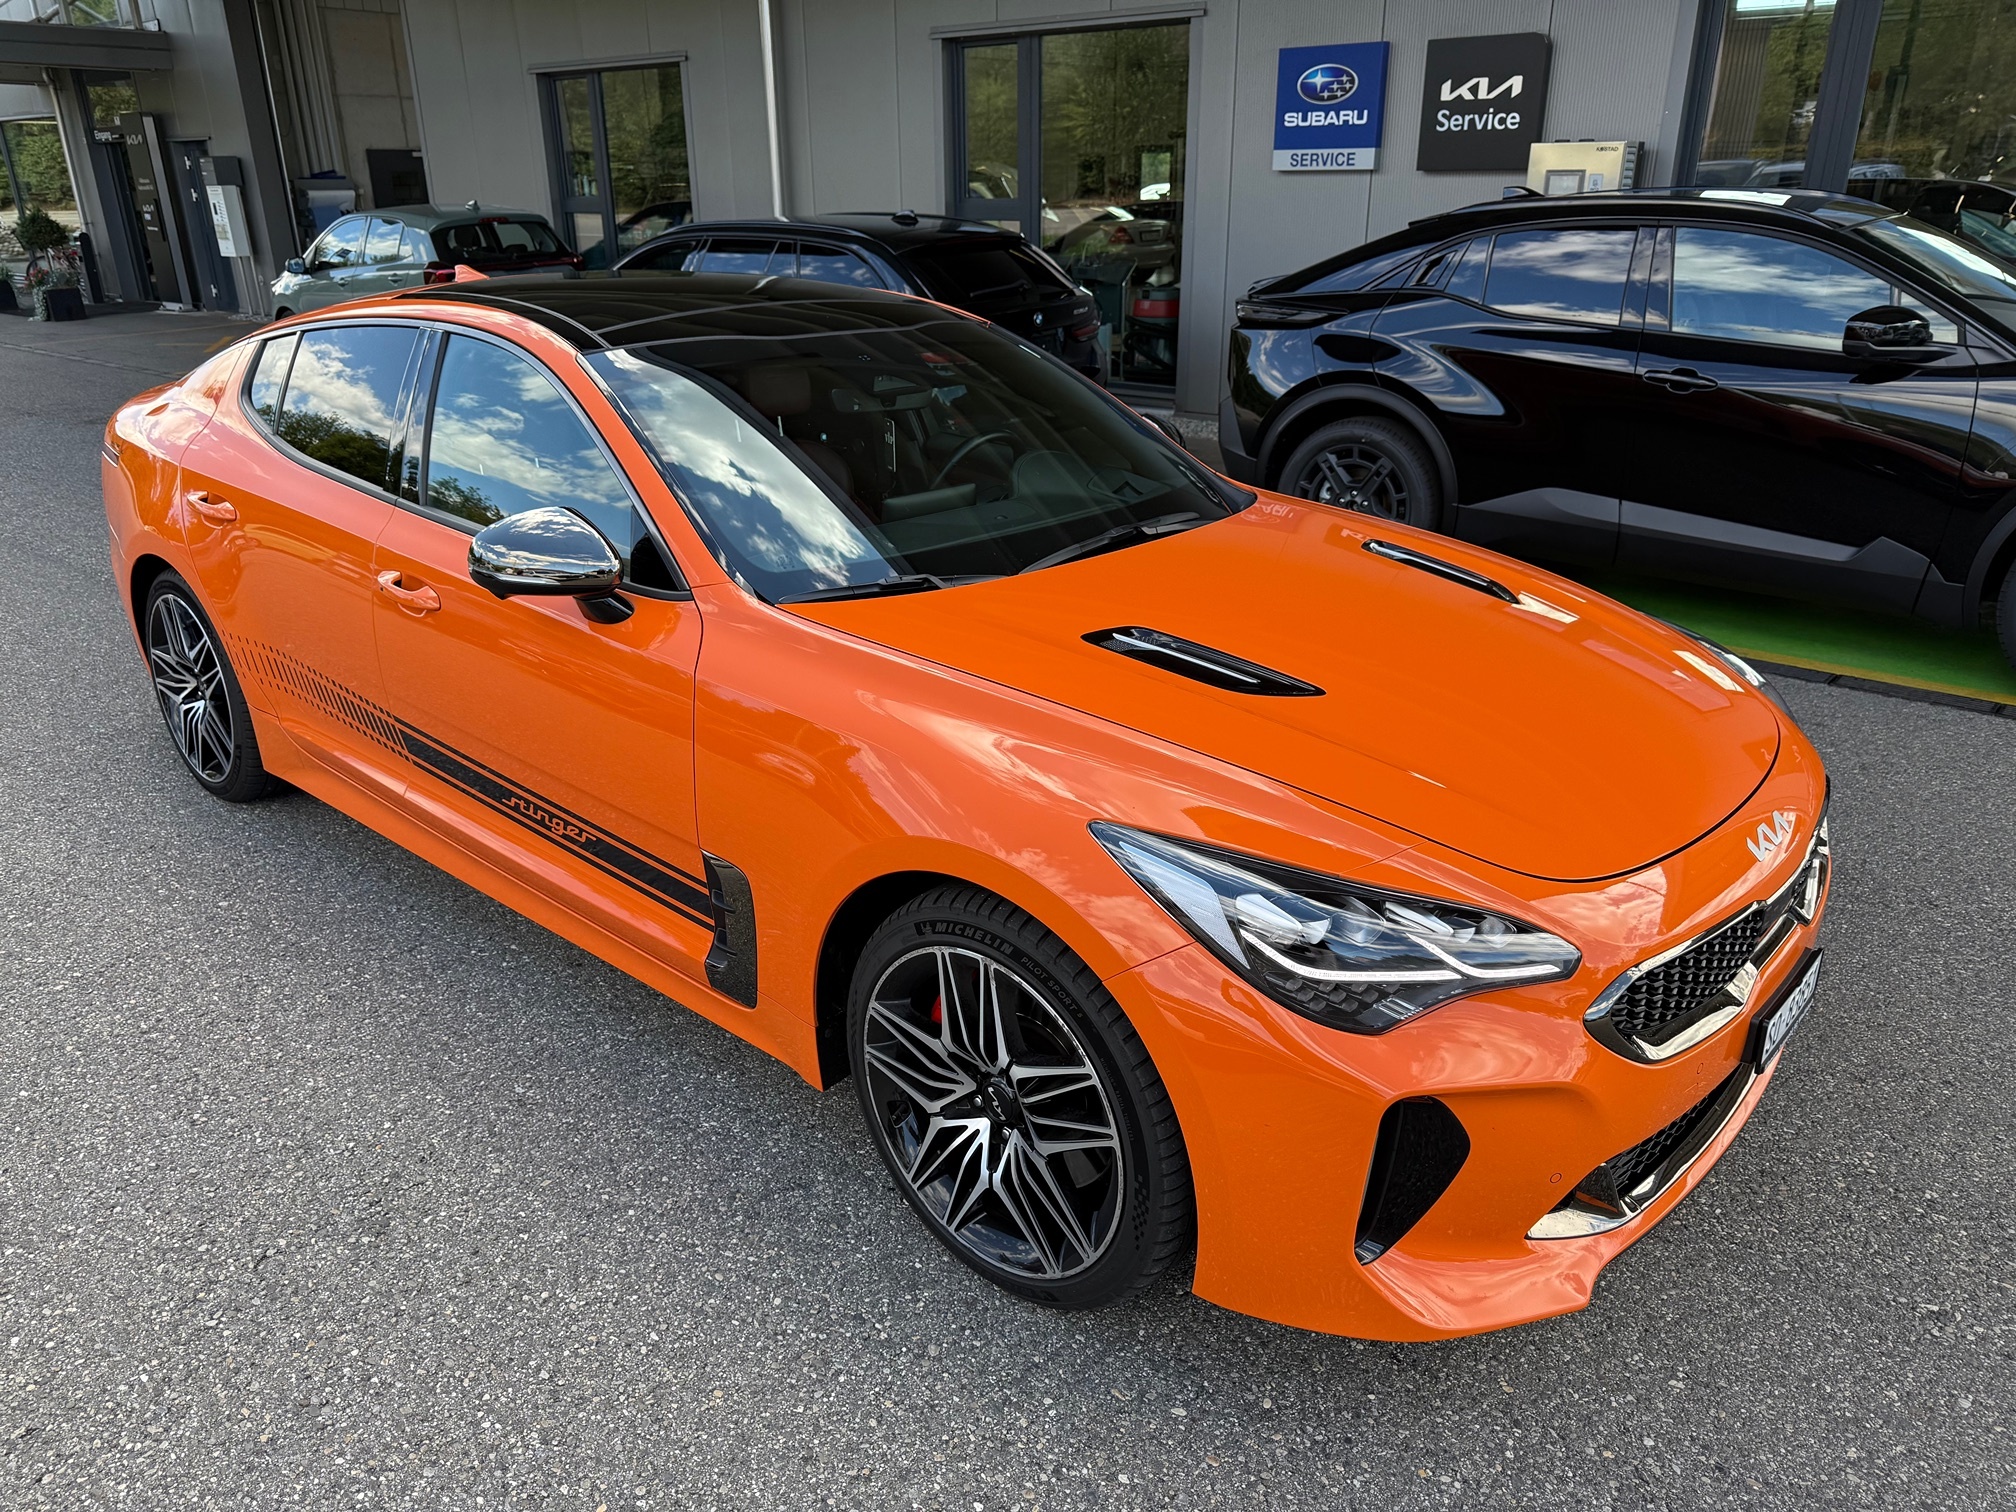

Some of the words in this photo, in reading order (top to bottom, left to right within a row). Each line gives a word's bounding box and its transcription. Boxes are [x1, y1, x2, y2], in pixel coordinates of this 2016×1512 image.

[1439, 75, 1524, 101] KIA
[1283, 109, 1368, 127] SUBARU
[1435, 108, 1521, 132] Service
[1289, 151, 1356, 168] SERVICE
[501, 797, 597, 843] stinger
[1746, 810, 1790, 862] KIA
[934, 921, 1015, 956] MICHELIN
[1020, 956, 1048, 980] PILOT
[1047, 979, 1078, 1011] SPORT
